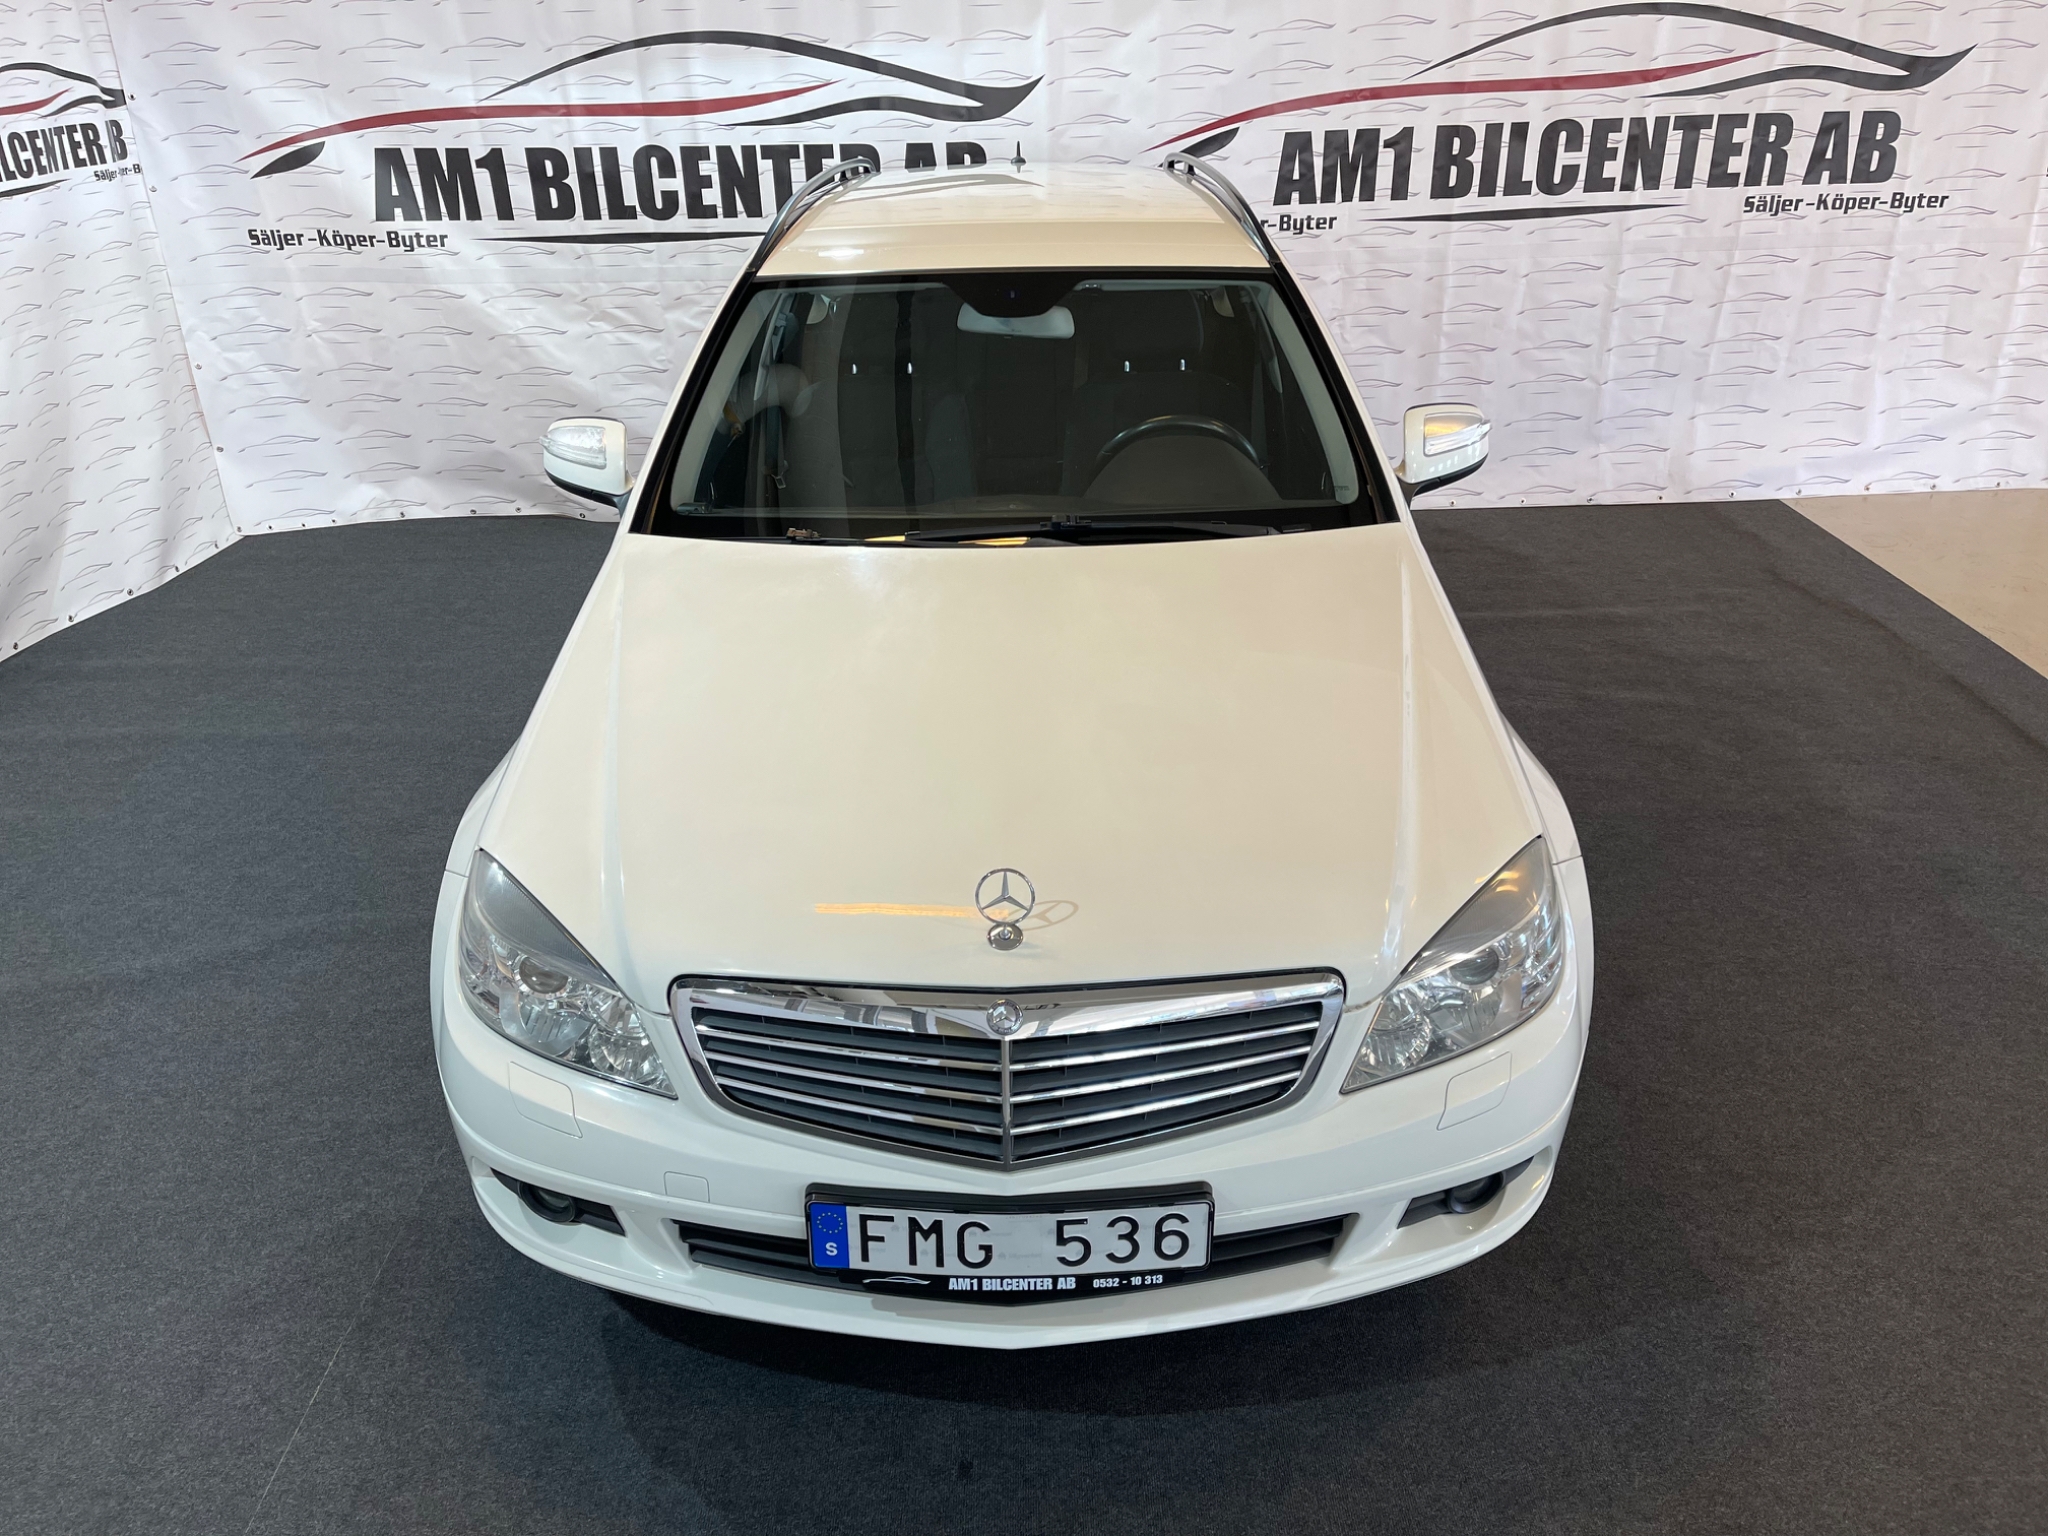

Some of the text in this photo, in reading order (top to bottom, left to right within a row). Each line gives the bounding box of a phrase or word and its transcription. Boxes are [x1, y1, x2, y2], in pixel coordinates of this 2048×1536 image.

[0, 122, 107, 182] LCENTER
[1273, 110, 1902, 206] AM1 BILCENTER AB
[374, 147, 515, 221] AM1
[825, 1242, 838, 1256] S
[859, 1212, 1190, 1270] FMG 536
[949, 1277, 1076, 1291] AM1 BILCENTER AB
[1093, 1278, 1120, 1288] 0532
[1131, 1276, 1142, 1286] 10
[1145, 1275, 1163, 1285] 313
